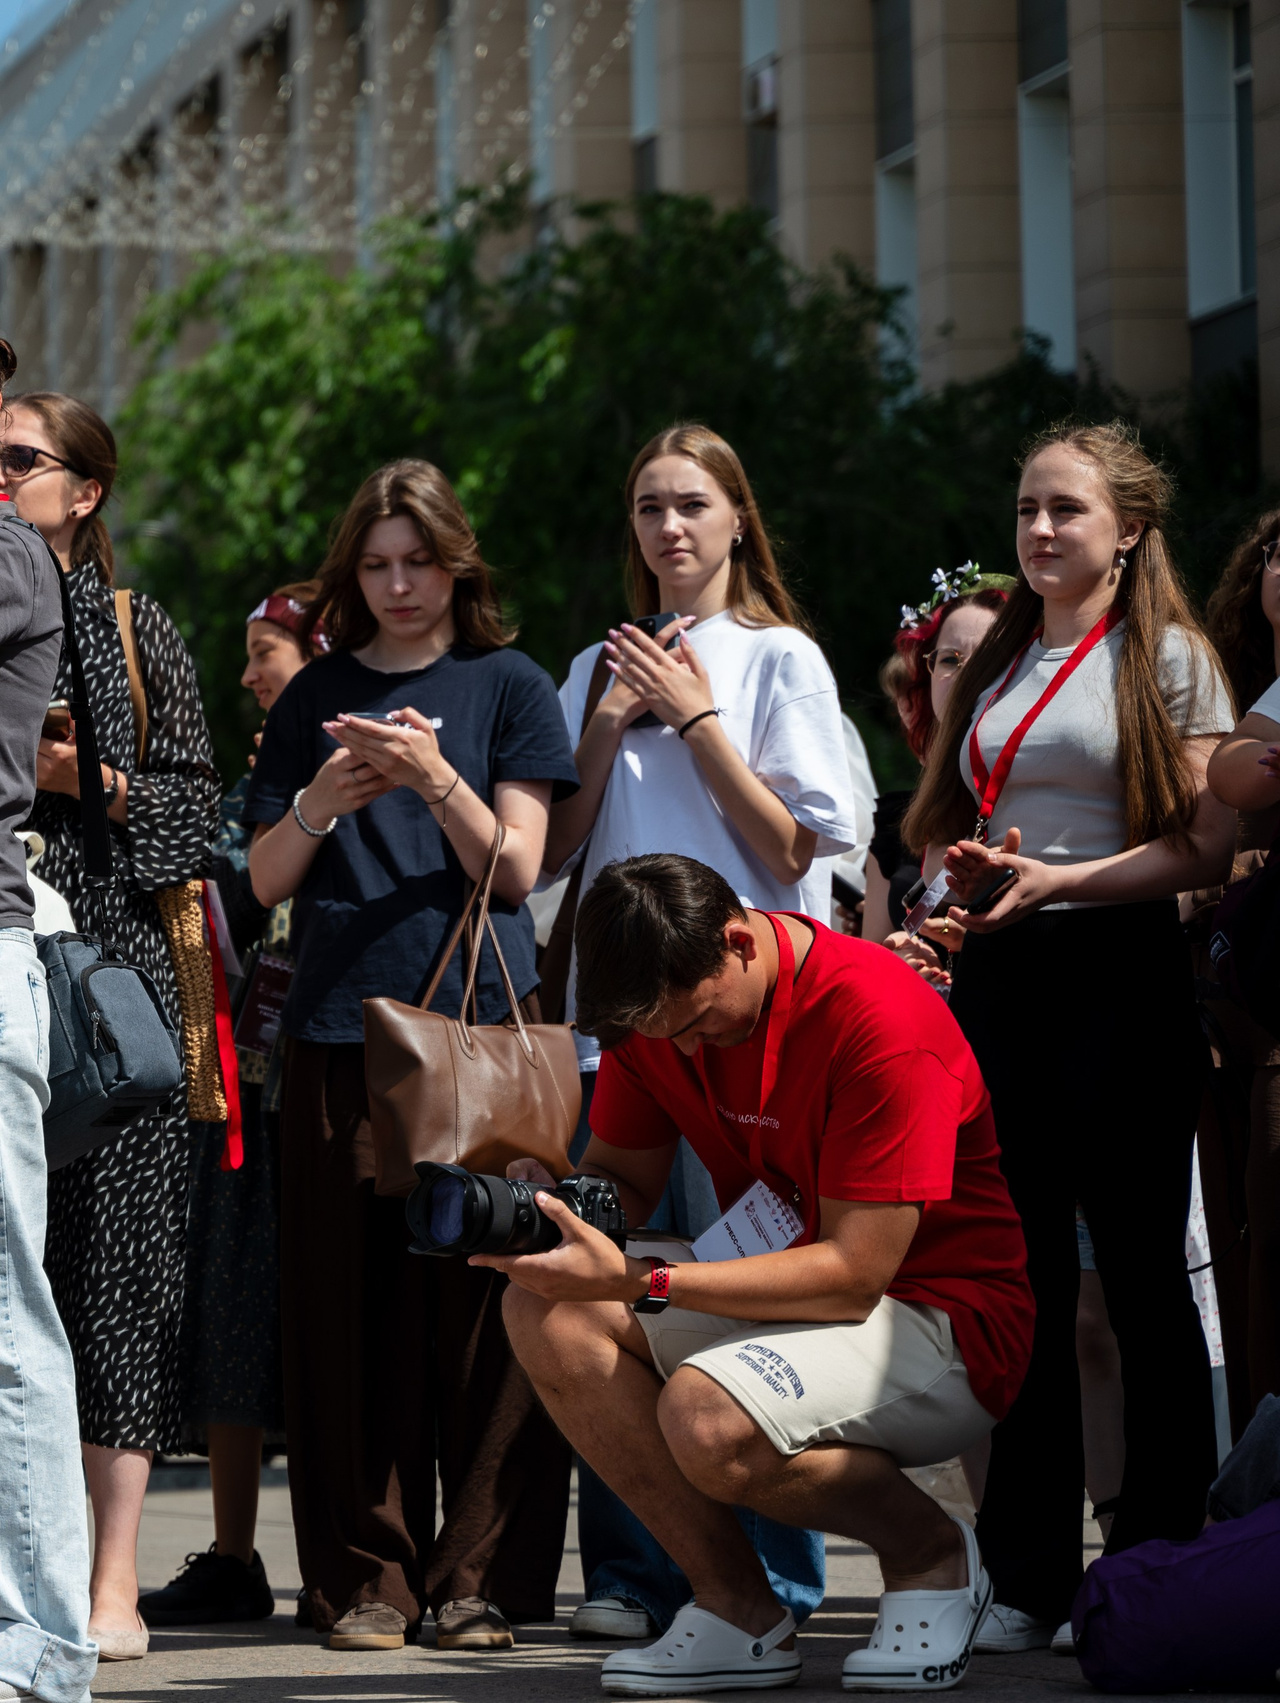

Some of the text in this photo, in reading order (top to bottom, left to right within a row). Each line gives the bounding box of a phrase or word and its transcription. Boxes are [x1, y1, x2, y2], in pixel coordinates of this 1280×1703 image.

[724, 1221, 747, 1258] ПРЕСС-СЛ
[735, 1352, 766, 1376] SUPERIOR
[762, 1373, 789, 1399] QUALITY
[740, 1343, 805, 1400] AUTHENTIC DIVISION
[922, 1644, 971, 1682] crocs
